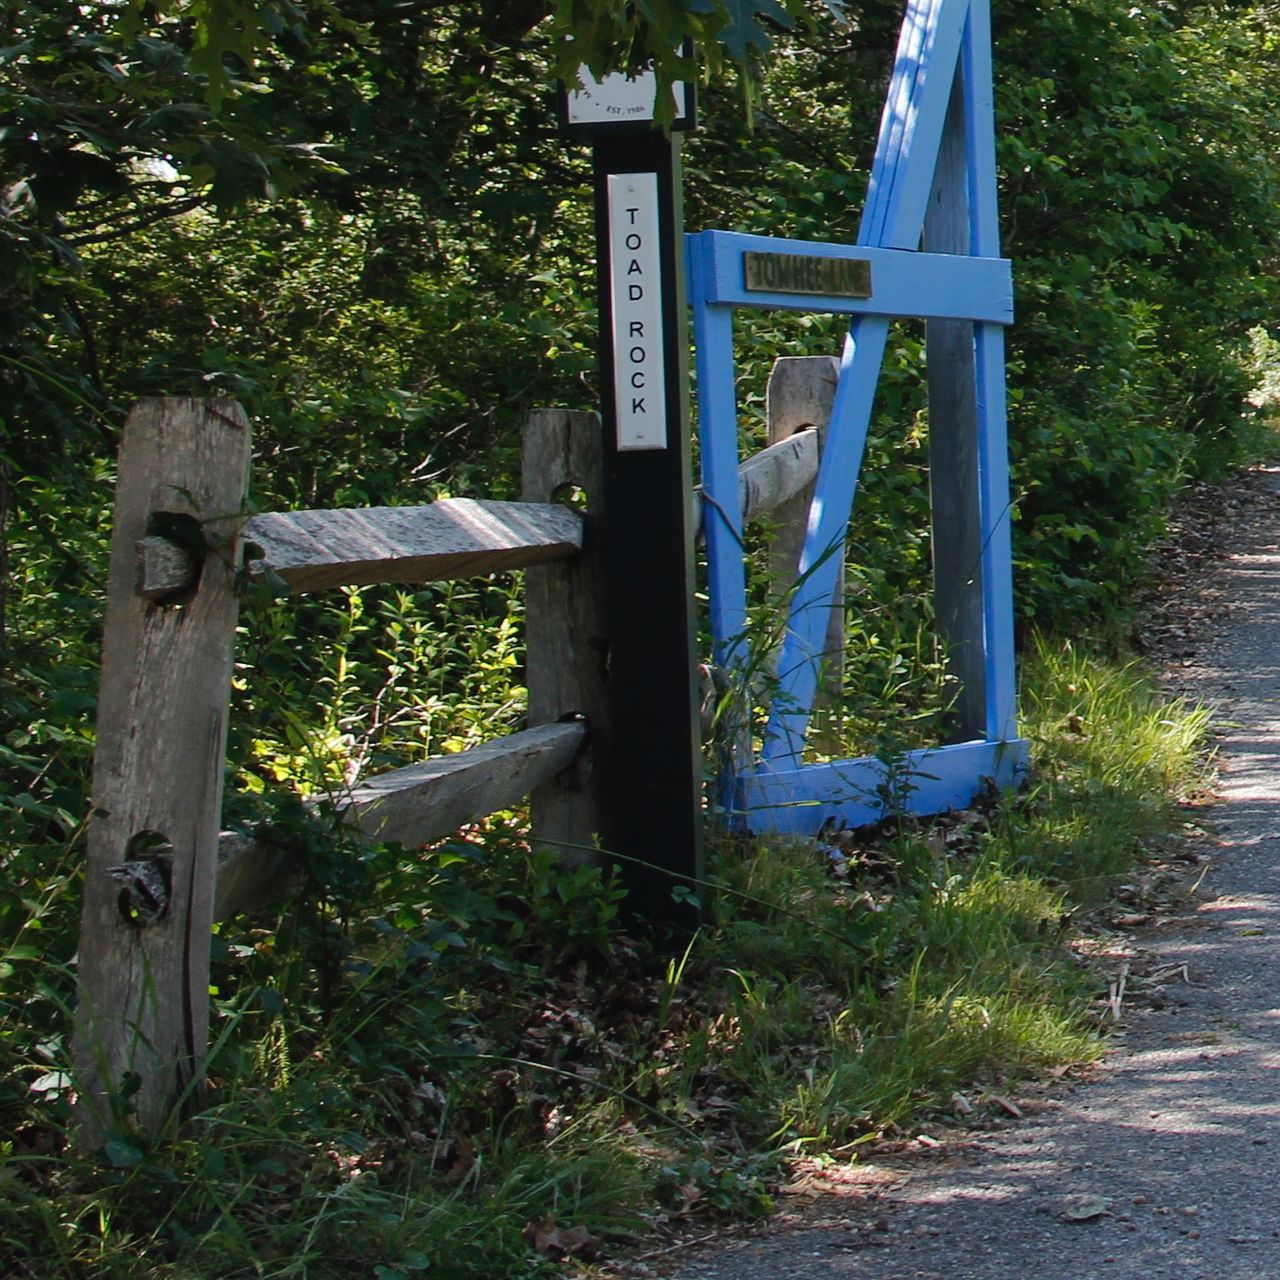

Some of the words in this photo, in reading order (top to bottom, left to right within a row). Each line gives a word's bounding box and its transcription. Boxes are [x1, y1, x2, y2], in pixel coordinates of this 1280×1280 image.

[625, 207, 644, 302] TOAD
[753, 252, 823, 291] TOWHEE
[629, 320, 647, 415] ROCK
